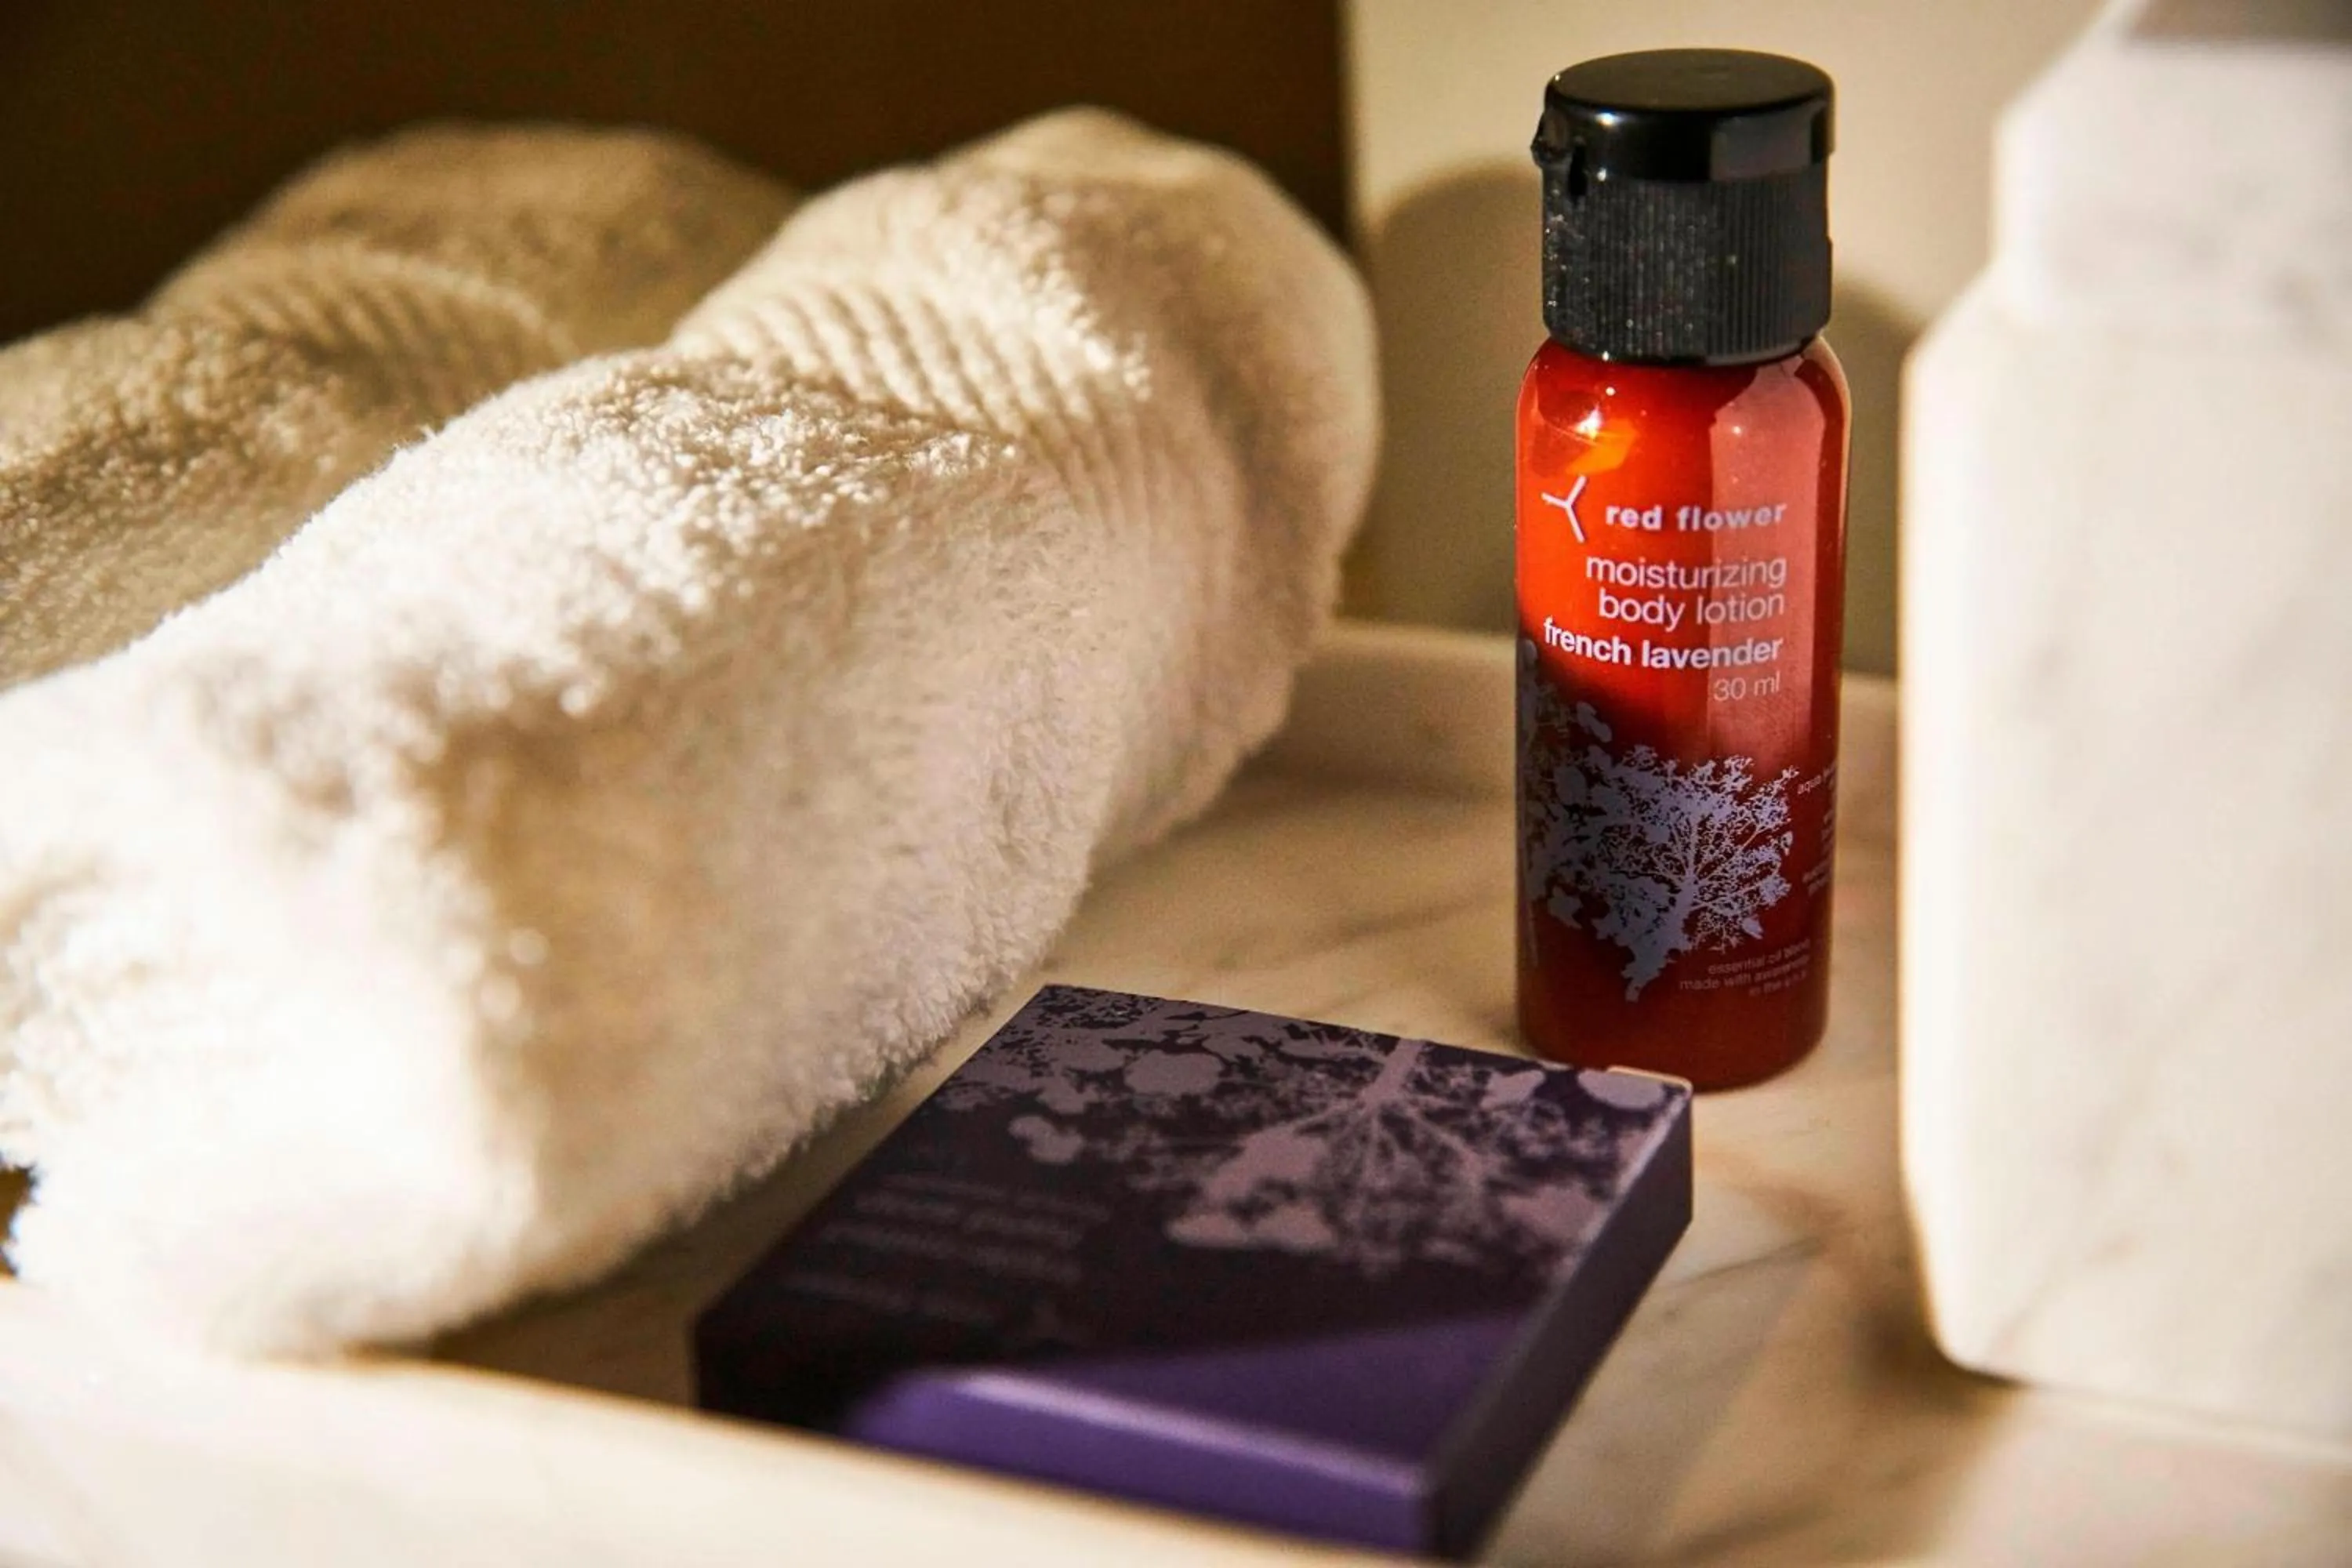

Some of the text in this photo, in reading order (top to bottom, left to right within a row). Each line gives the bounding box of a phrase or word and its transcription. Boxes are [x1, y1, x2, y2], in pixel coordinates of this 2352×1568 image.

[1606, 504, 1788, 531] red flower
[1586, 556, 1788, 588] moisturizing
[1599, 589, 1785, 632] body lotion
[1544, 616, 1784, 670] french lavender
[1714, 671, 1780, 701] 30 ml
[1679, 977, 1721, 990] made
